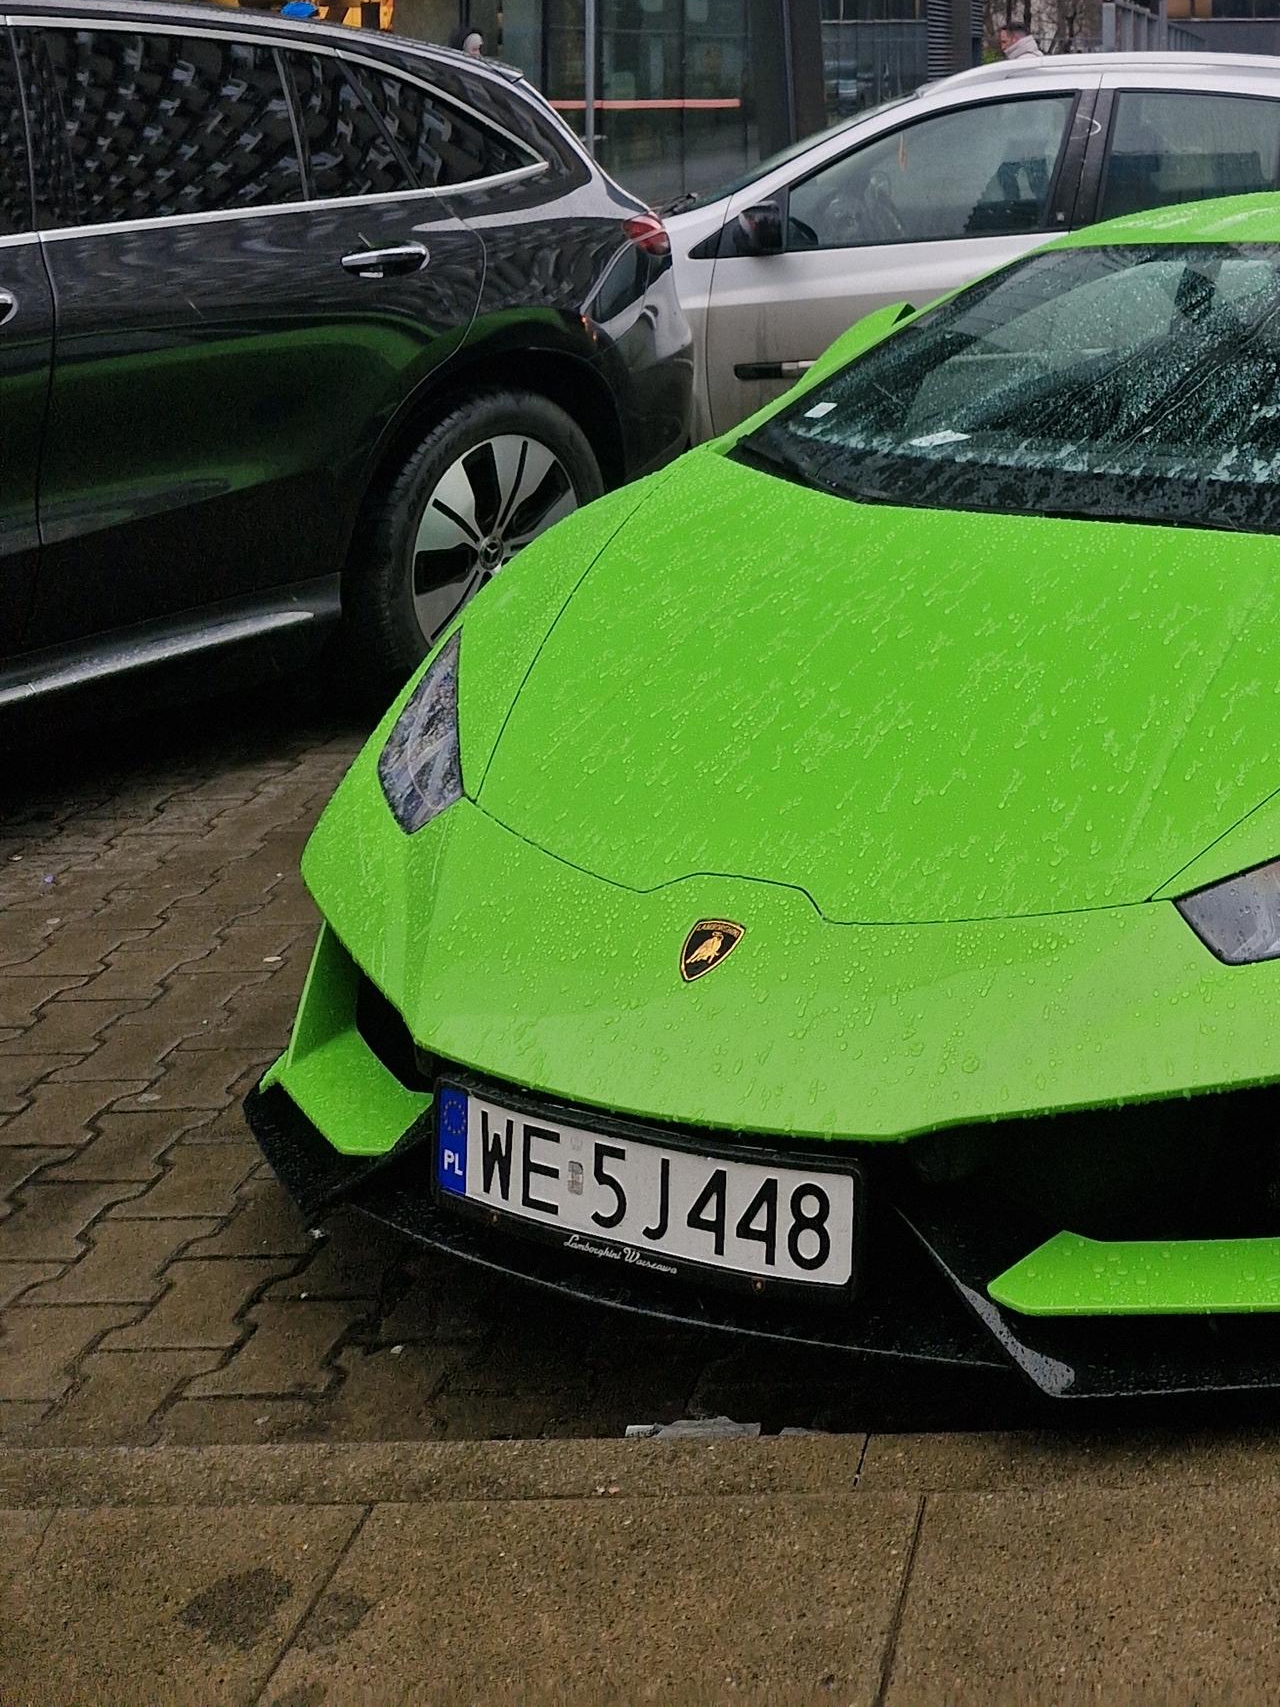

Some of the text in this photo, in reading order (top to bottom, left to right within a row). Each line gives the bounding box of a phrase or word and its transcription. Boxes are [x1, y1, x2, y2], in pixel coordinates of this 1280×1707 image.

[443, 1149, 463, 1176] PL
[481, 1110, 831, 1271] WE 5J448
[563, 1234, 677, 1274] Lamborghini Warszawa
